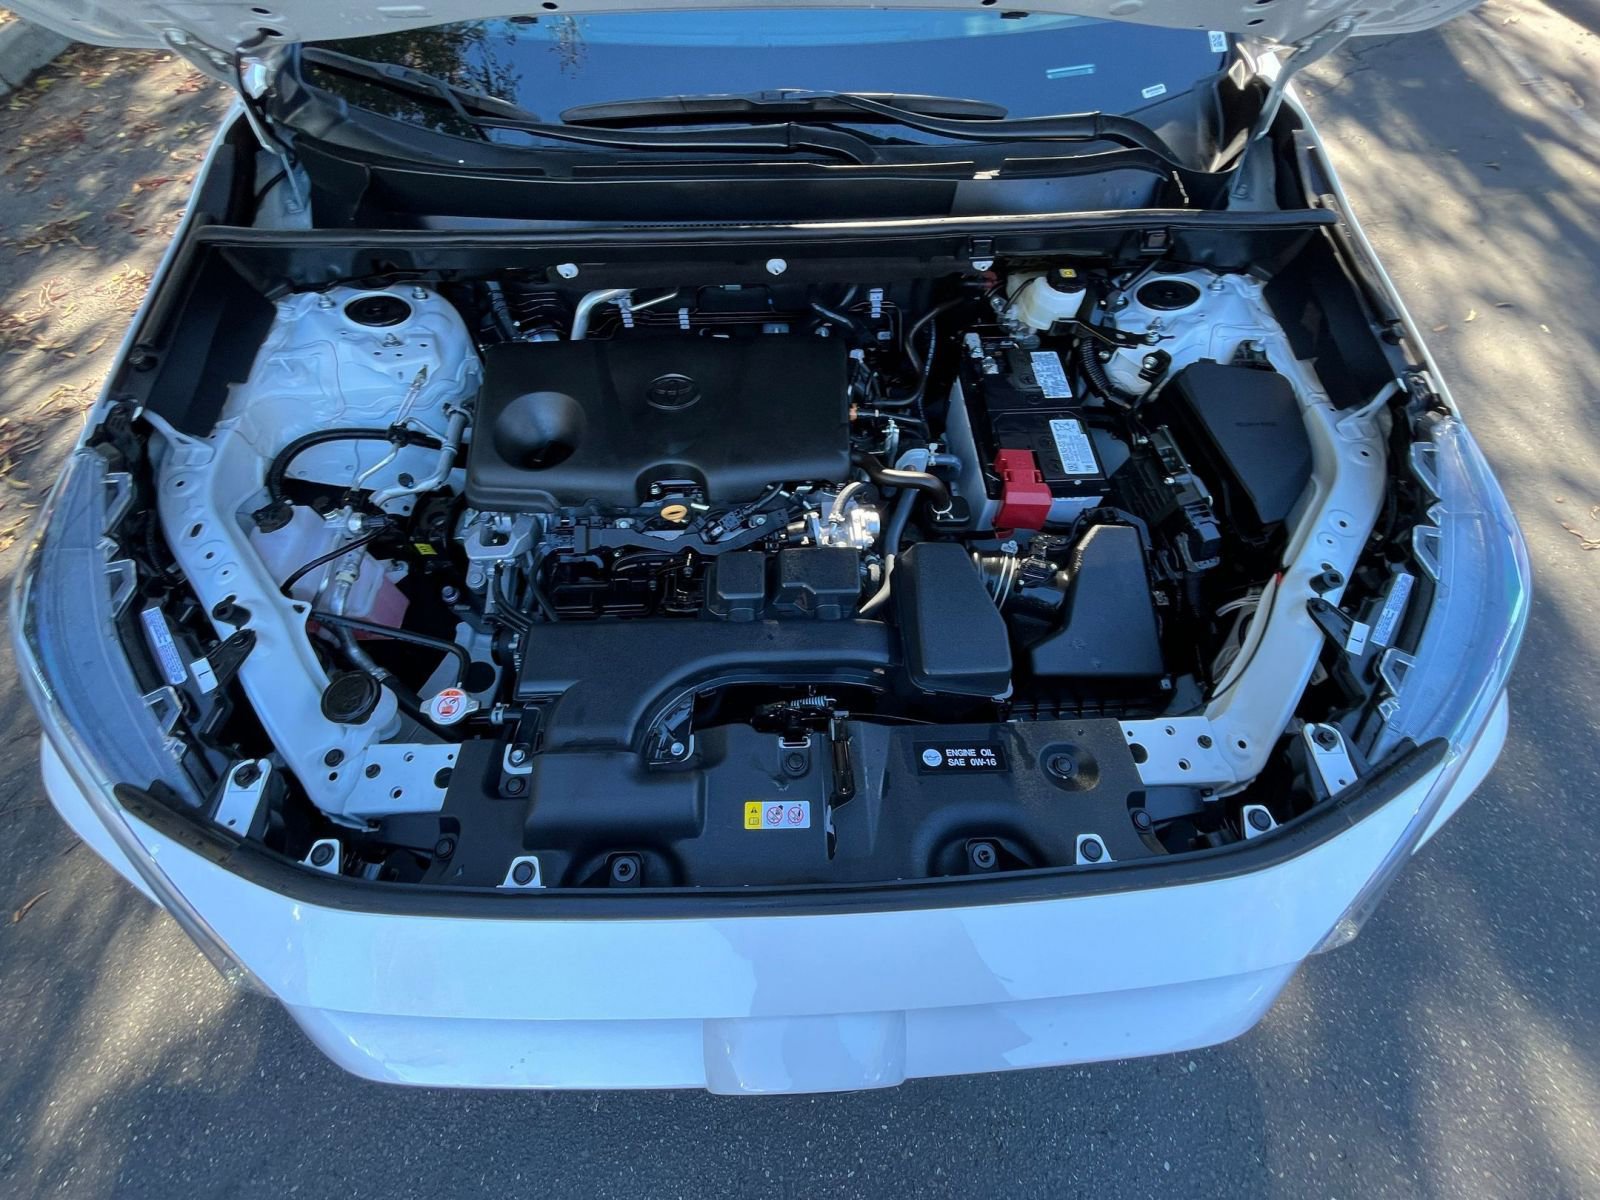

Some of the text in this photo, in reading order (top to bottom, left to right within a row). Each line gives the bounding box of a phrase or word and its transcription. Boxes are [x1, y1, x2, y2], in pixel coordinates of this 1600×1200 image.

[945, 748, 996, 757] ENGINE OIL
[947, 758, 997, 766] SAE 0W-16
